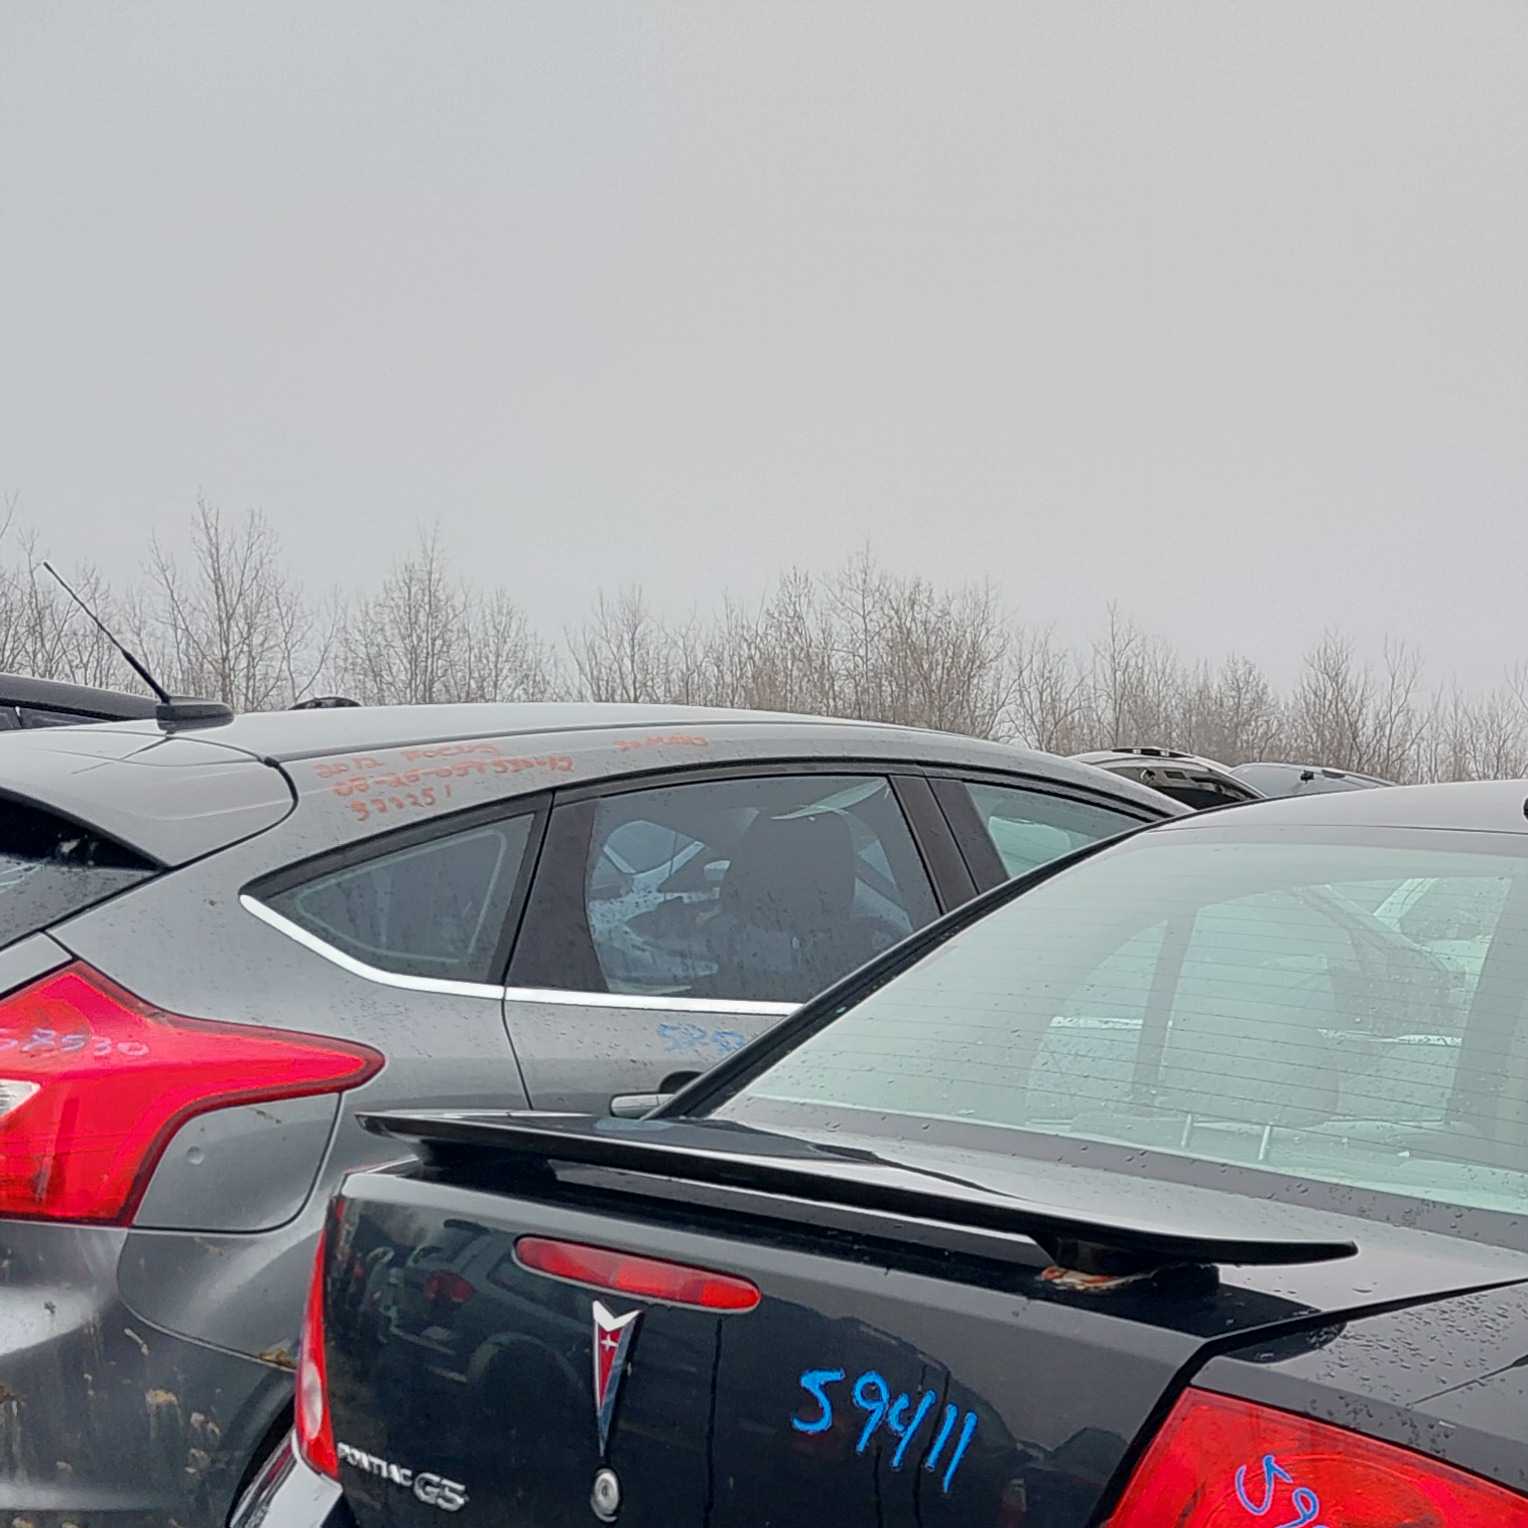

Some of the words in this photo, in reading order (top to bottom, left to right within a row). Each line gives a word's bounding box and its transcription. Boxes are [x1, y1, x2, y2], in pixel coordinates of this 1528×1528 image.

[337, 1441, 413, 1487] PONTIAC
[413, 1471, 467, 1512] G5
[791, 1367, 978, 1494] 59411
